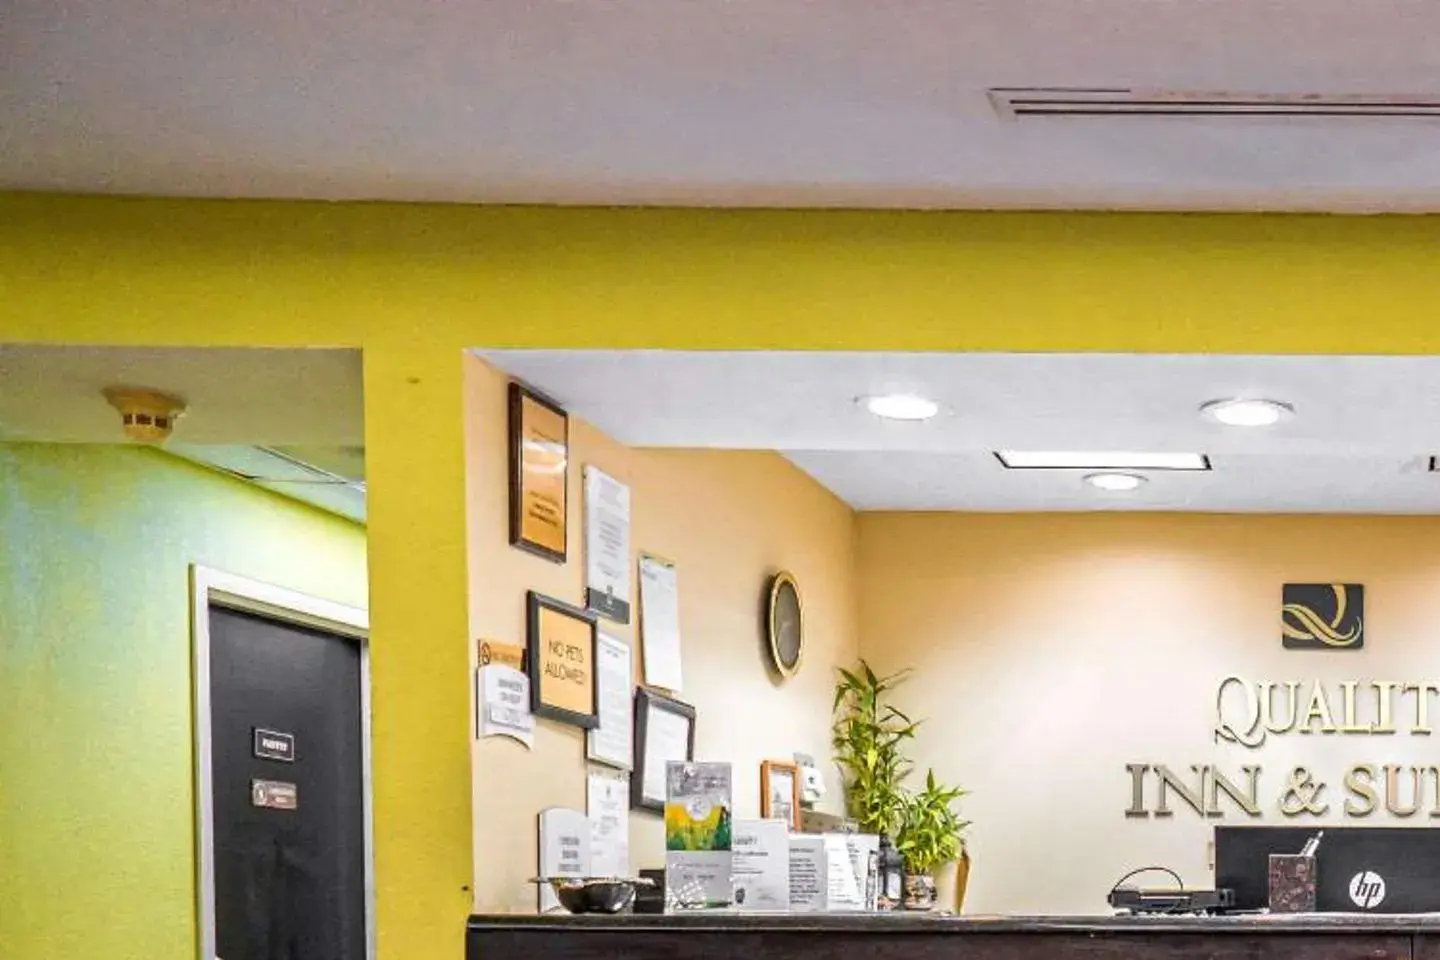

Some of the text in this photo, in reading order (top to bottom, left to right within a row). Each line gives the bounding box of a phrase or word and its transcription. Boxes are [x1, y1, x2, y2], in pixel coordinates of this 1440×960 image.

[549, 639, 565, 662] NO
[565, 644, 584, 663] PETS
[1125, 763, 1262, 818] INN
[1277, 766, 1328, 816] &
[1352, 871, 1383, 908] hp
